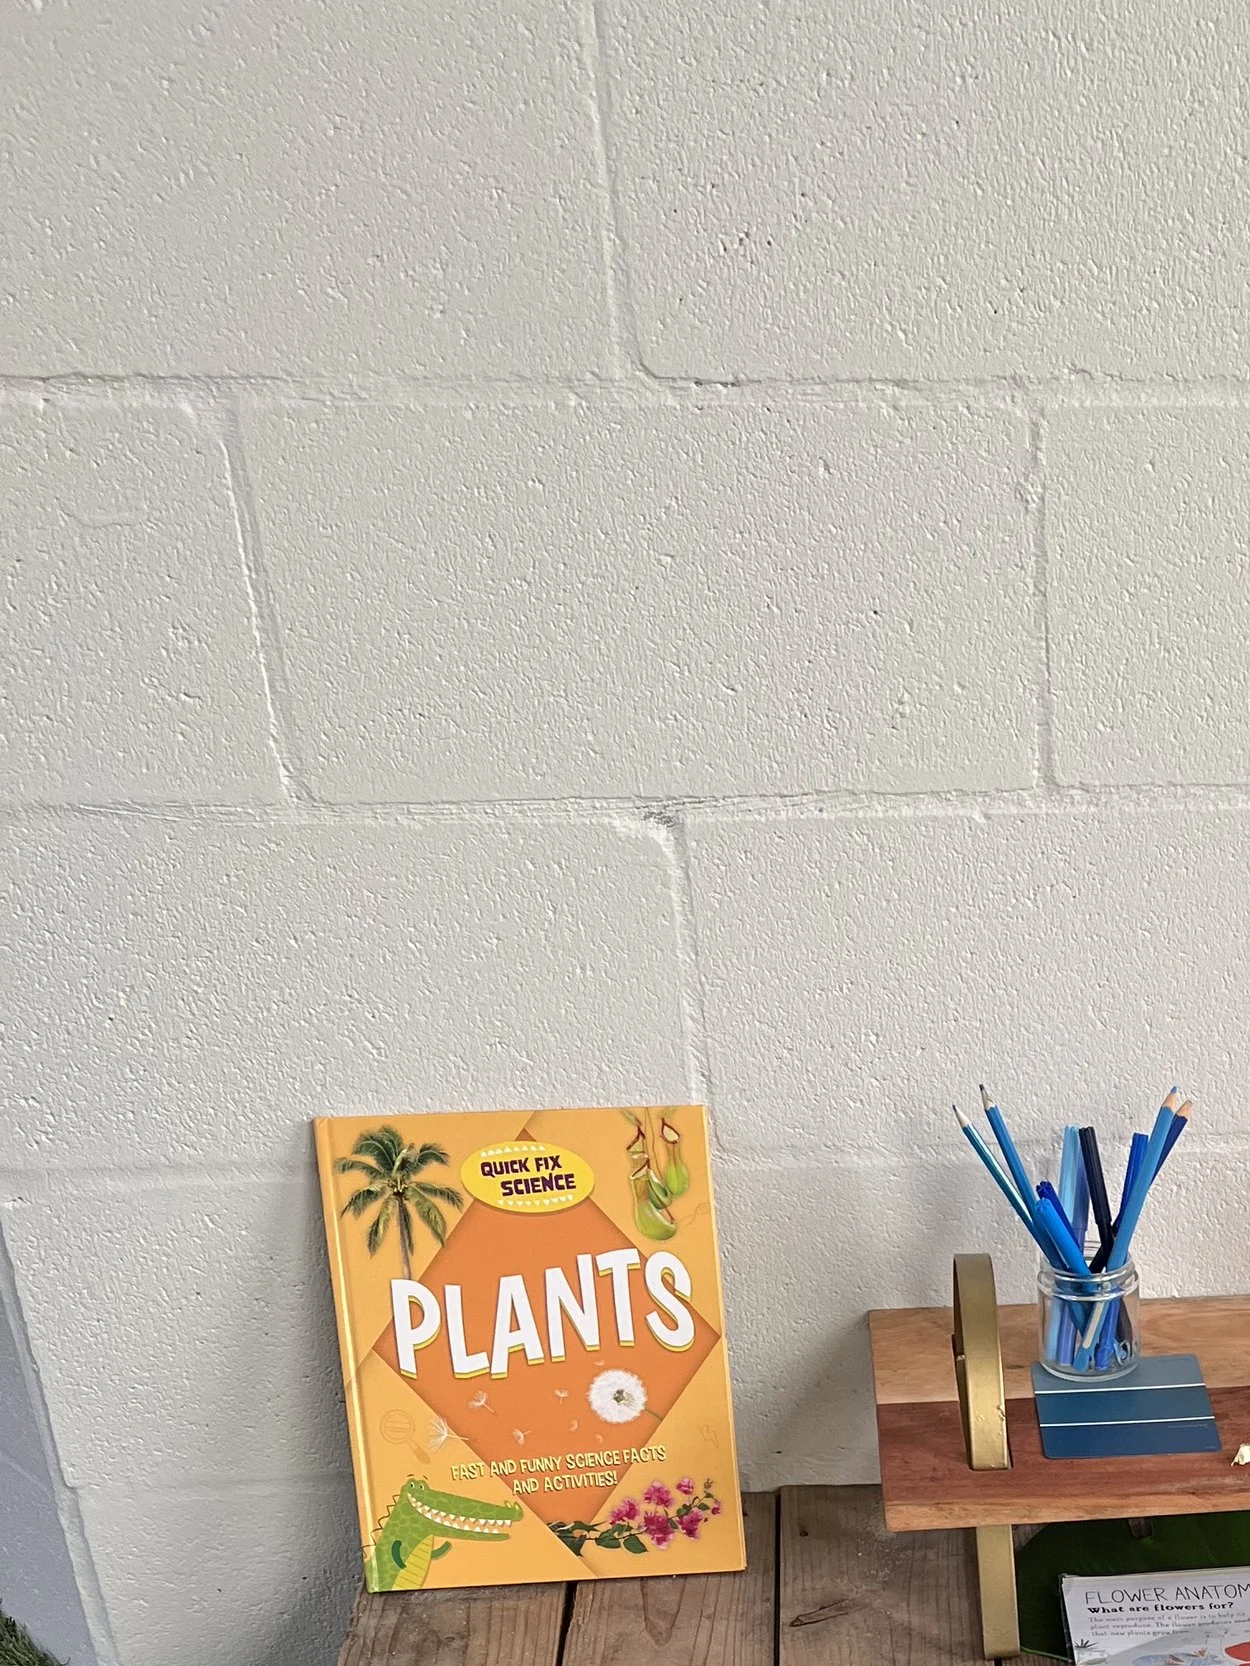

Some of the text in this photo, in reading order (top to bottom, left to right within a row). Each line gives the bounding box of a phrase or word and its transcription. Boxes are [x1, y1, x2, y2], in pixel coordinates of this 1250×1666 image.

[480, 1155, 562, 1176] QUICK FIX
[500, 1174, 576, 1196] SCIENCE
[391, 1248, 696, 1380] PLANTS
[451, 1445, 666, 1482] FAST AND FUNNY SCIENCE FACTS
[512, 1470, 618, 1496] AND ACTIVITIES!
[1085, 1586, 1167, 1604] FLOWER
[1154, 1604, 1204, 1612] flowers
[1209, 1602, 1234, 1610] for?
